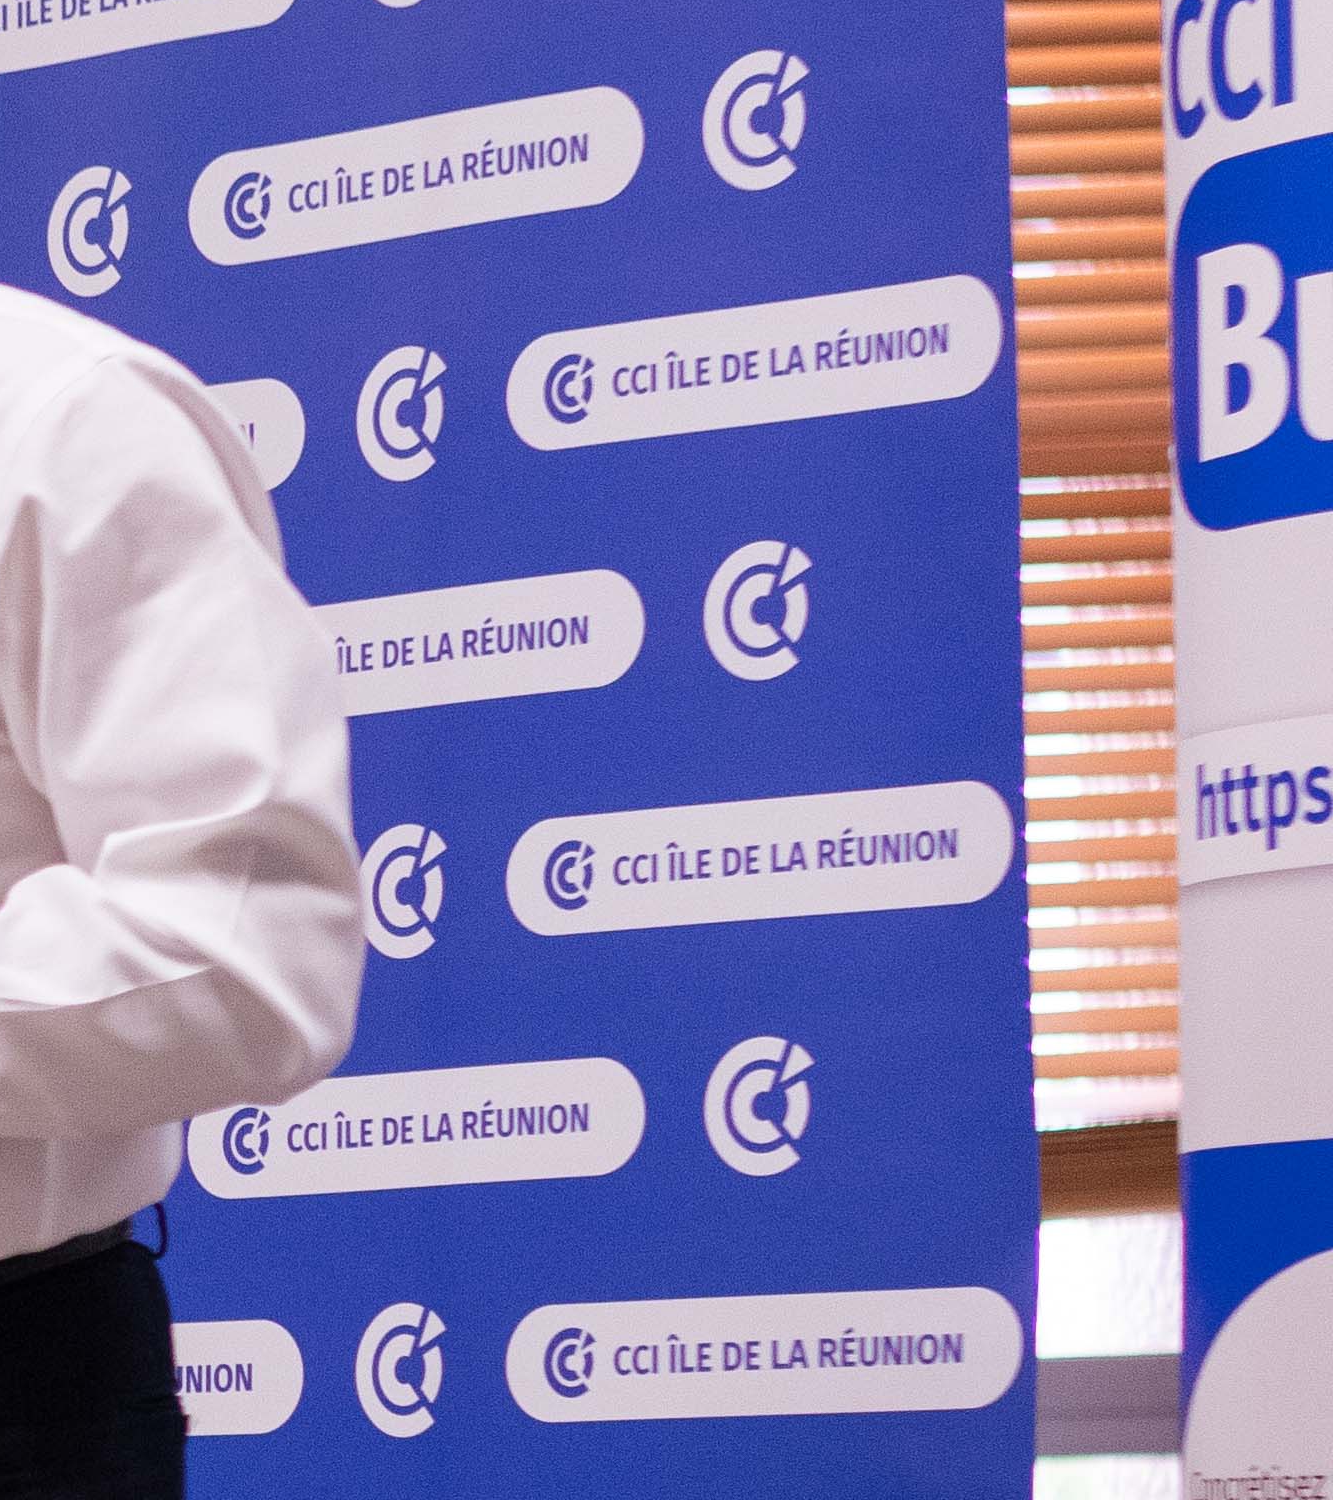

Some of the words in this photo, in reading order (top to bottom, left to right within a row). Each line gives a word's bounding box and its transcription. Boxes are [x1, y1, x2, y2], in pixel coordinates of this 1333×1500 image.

[288, 180, 327, 212] CCI
[336, 167, 374, 204] ÎLE
[383, 164, 414, 196] DE
[424, 157, 454, 188] LA
[463, 134, 588, 181] RÉUNION
[613, 364, 656, 397] CCI
[666, 351, 710, 389] ÎLE
[722, 350, 759, 383] DE
[770, 345, 805, 377] LA
[816, 325, 948, 370] RÉUNION
[335, 637, 373, 674] ÎLE
[383, 637, 414, 668] DE
[423, 632, 454, 663] LA
[462, 616, 588, 657] RÉUNION
[1196, 764, 1333, 851] https
[613, 854, 657, 886] CCI
[667, 842, 711, 880] ÎLE
[723, 845, 760, 876] DE
[771, 842, 807, 872] LA
[818, 829, 957, 868] RÉUNION
[286, 1119, 327, 1152] CCI
[335, 1111, 373, 1148] ÎLE
[382, 1115, 413, 1146] DE
[423, 1113, 453, 1142] LA
[462, 1104, 588, 1139] RÉUNION
[174, 1363, 253, 1393] UNION
[614, 1345, 658, 1376] CCI
[668, 1334, 712, 1373] ÎLE
[723, 1341, 760, 1371] DE
[772, 1340, 808, 1369] LA
[819, 1328, 963, 1367] RÉUNION
